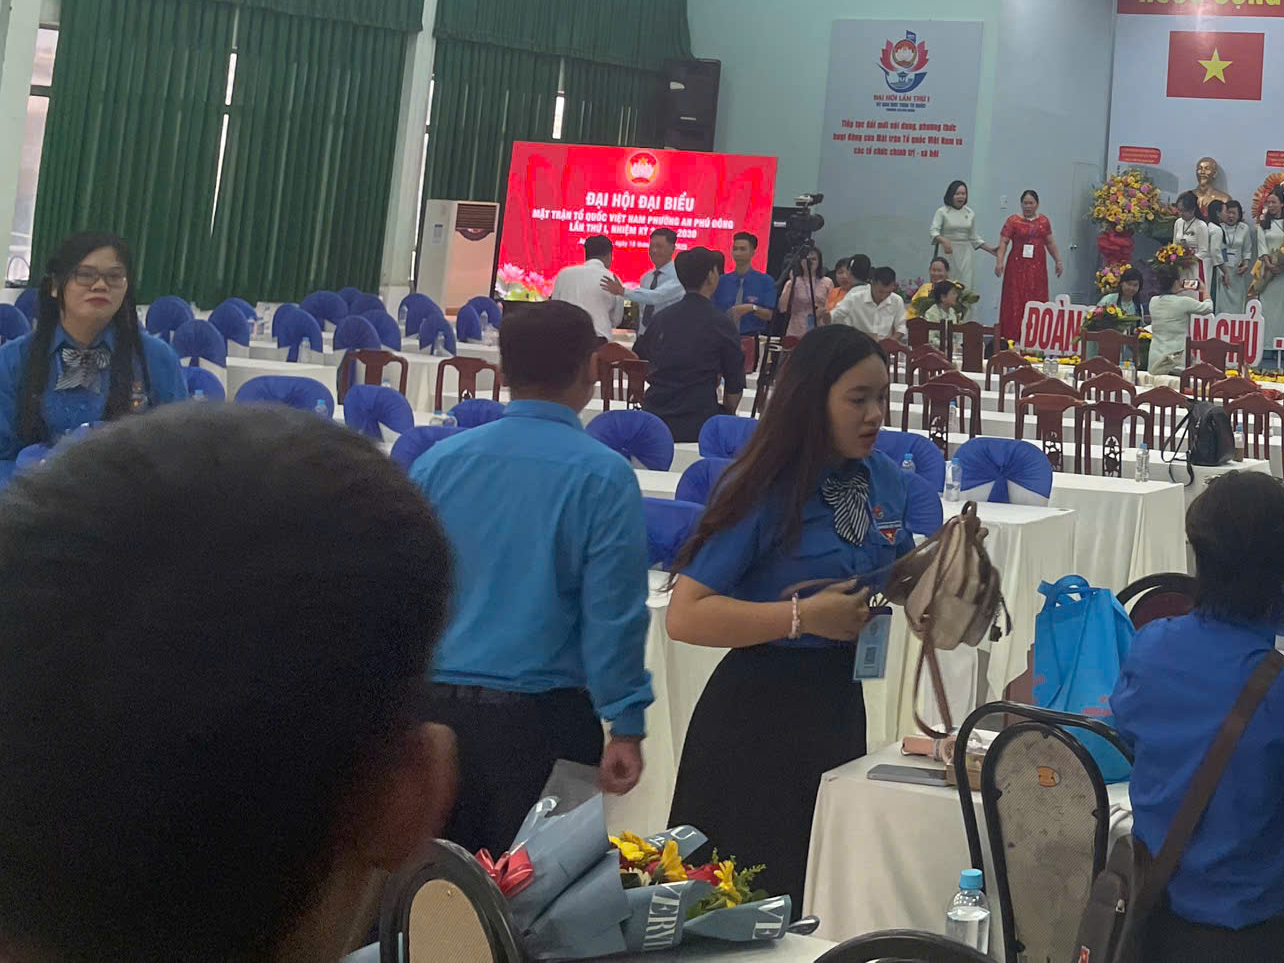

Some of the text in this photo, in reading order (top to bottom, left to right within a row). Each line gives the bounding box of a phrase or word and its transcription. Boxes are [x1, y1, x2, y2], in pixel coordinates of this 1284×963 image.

[586, 191, 695, 212] ĐẠI HỘI ĐẠI BIỂU
[1024, 300, 1083, 352] ĐOÀN
